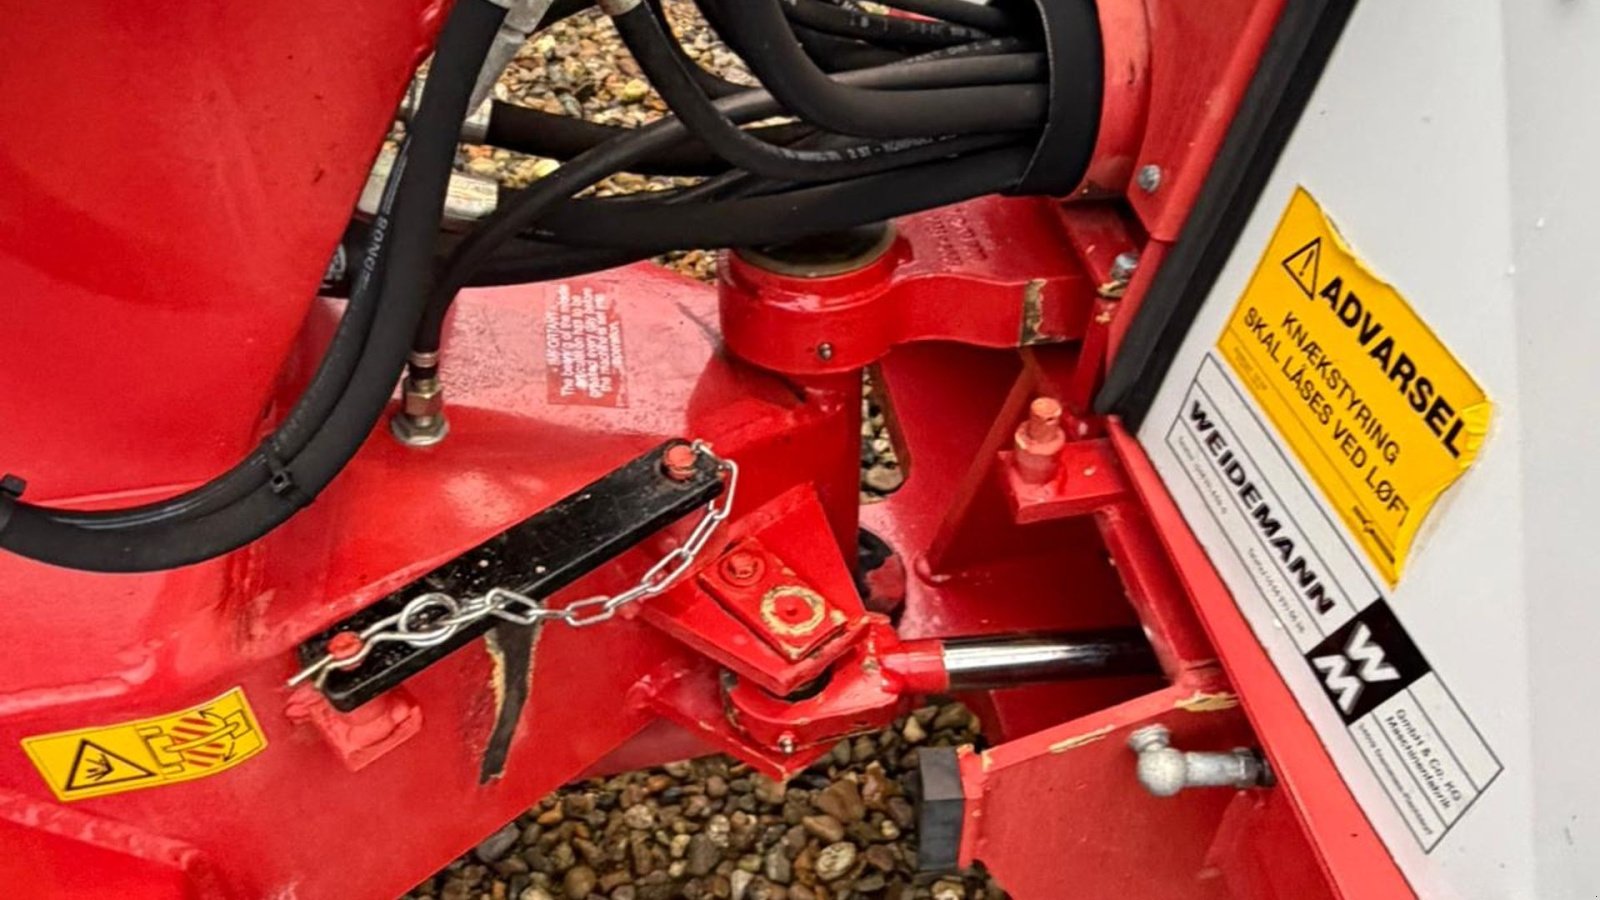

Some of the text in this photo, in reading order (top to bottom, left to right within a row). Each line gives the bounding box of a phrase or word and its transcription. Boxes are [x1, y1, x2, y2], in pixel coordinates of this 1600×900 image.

[1244, 307, 1281, 363] SKAL
[1281, 355, 1334, 425] LÅSES
[1331, 418, 1368, 469] VED
[1281, 311, 1400, 466] KNÆKSTYRING
[1319, 275, 1465, 460] ADVARSEL
[1189, 400, 1336, 615] WEIDEMANN
